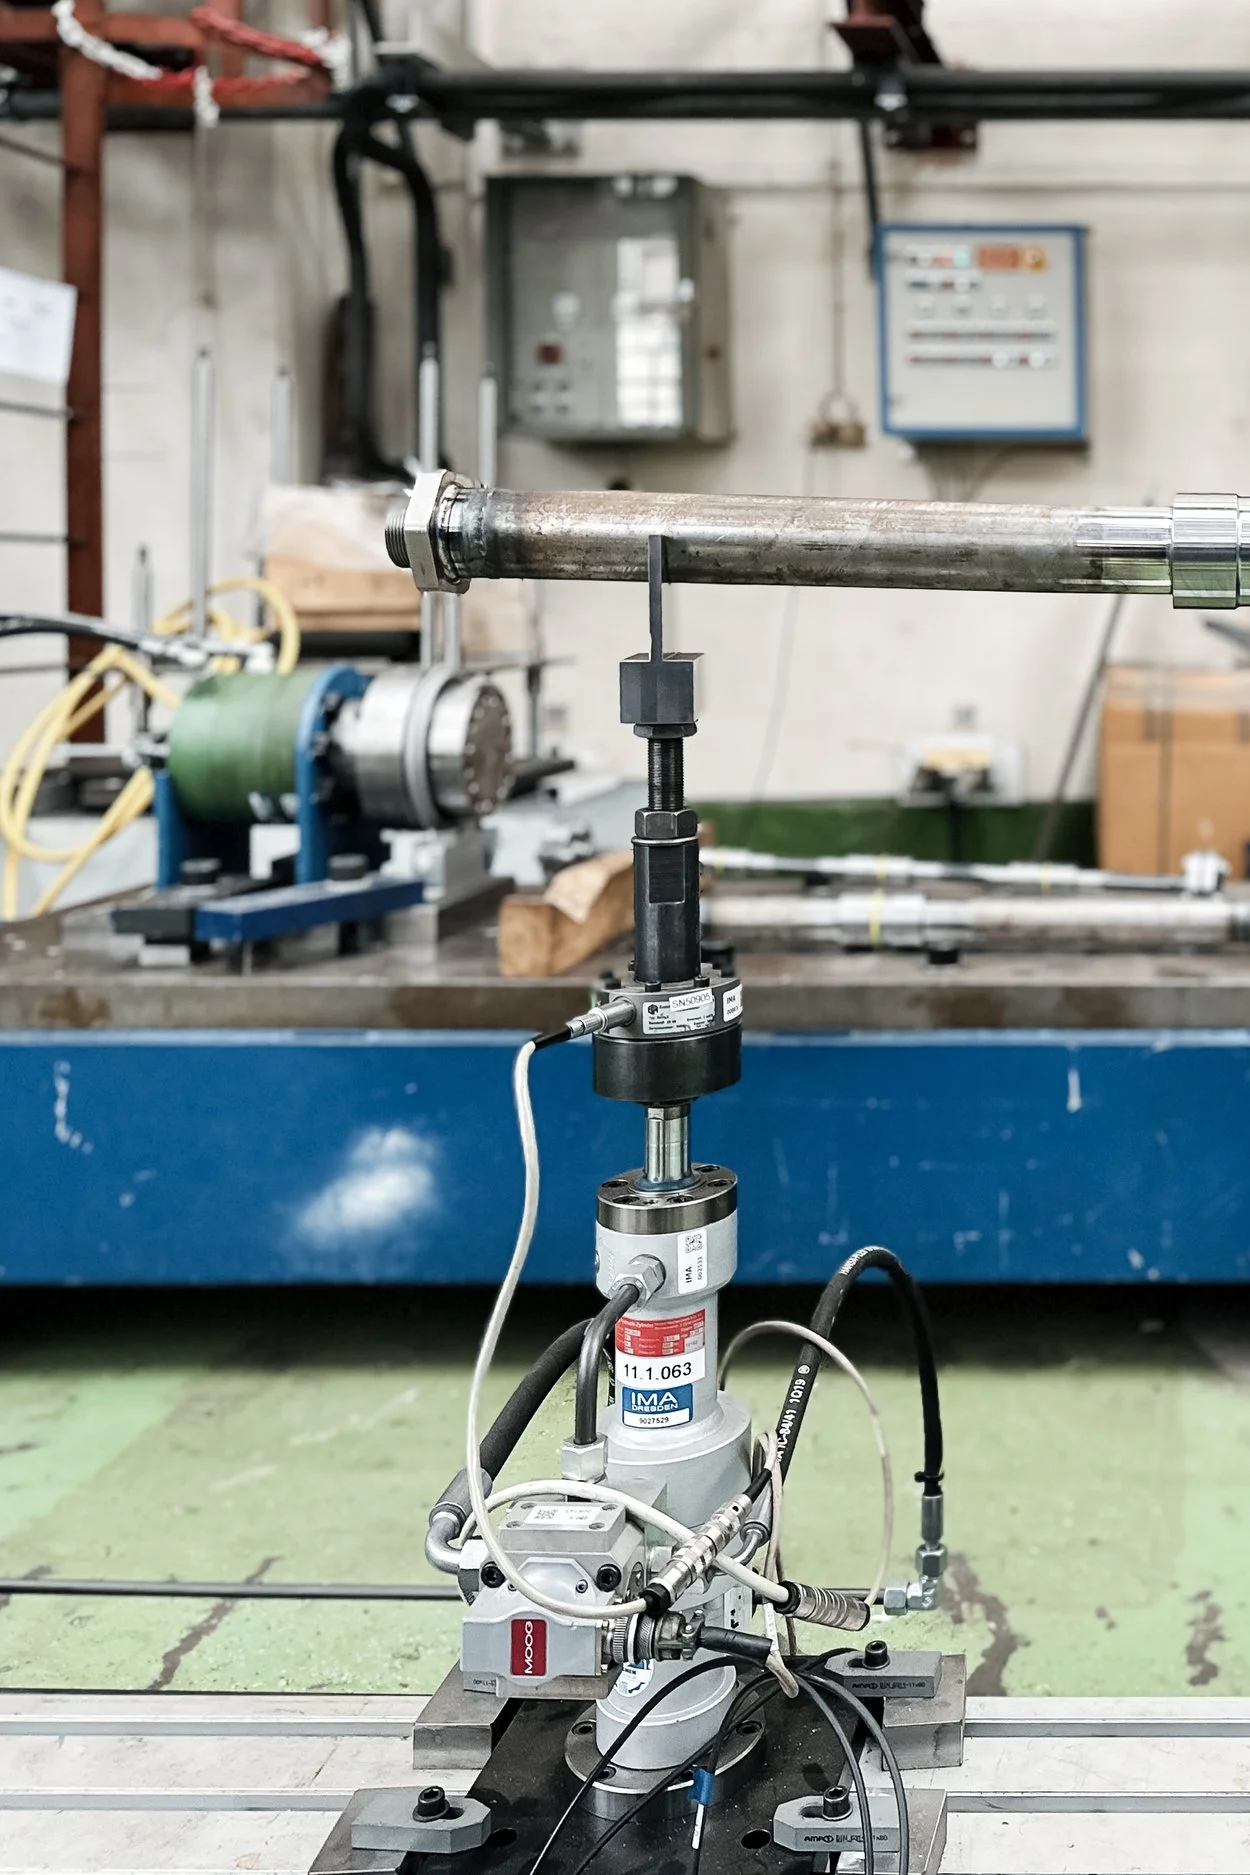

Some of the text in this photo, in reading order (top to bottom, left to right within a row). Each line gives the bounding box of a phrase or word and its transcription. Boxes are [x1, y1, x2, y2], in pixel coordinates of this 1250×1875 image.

[671, 992, 711, 1009] SN50905
[685, 1265, 693, 1283] IMA
[624, 1361, 692, 1380] 11.1.063
[631, 1391, 678, 1406] IMA
[632, 1403, 679, 1412] DRESDEN
[524, 1620, 534, 1674] MOOG
